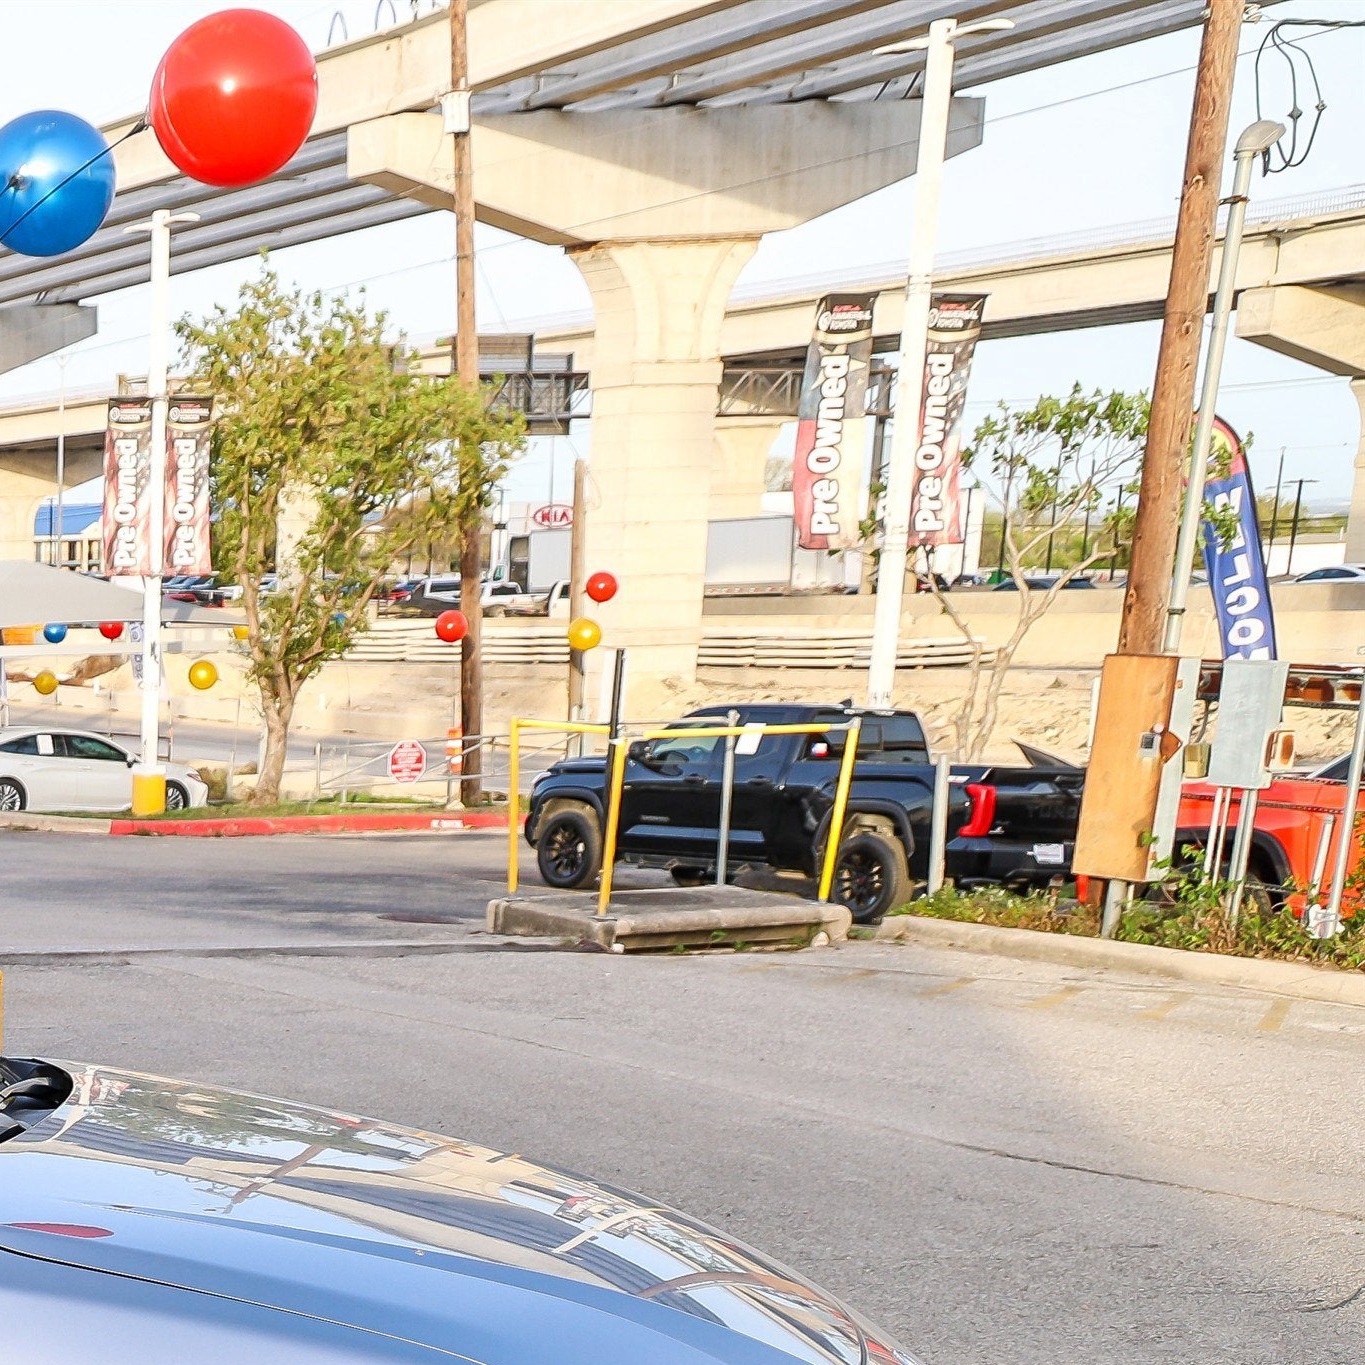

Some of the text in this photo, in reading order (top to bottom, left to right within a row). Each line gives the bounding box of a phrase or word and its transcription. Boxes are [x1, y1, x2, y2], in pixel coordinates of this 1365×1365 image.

[807, 353, 851, 474] Owned
[915, 352, 956, 472] Owned
[114, 438, 139, 523] Owned
[173, 437, 197, 523] Owned
[810, 477, 840, 535] Pre
[914, 474, 944, 532] Pre
[541, 509, 570, 523] KIA
[113, 524, 138, 567] Pre
[172, 524, 197, 567] Pre
